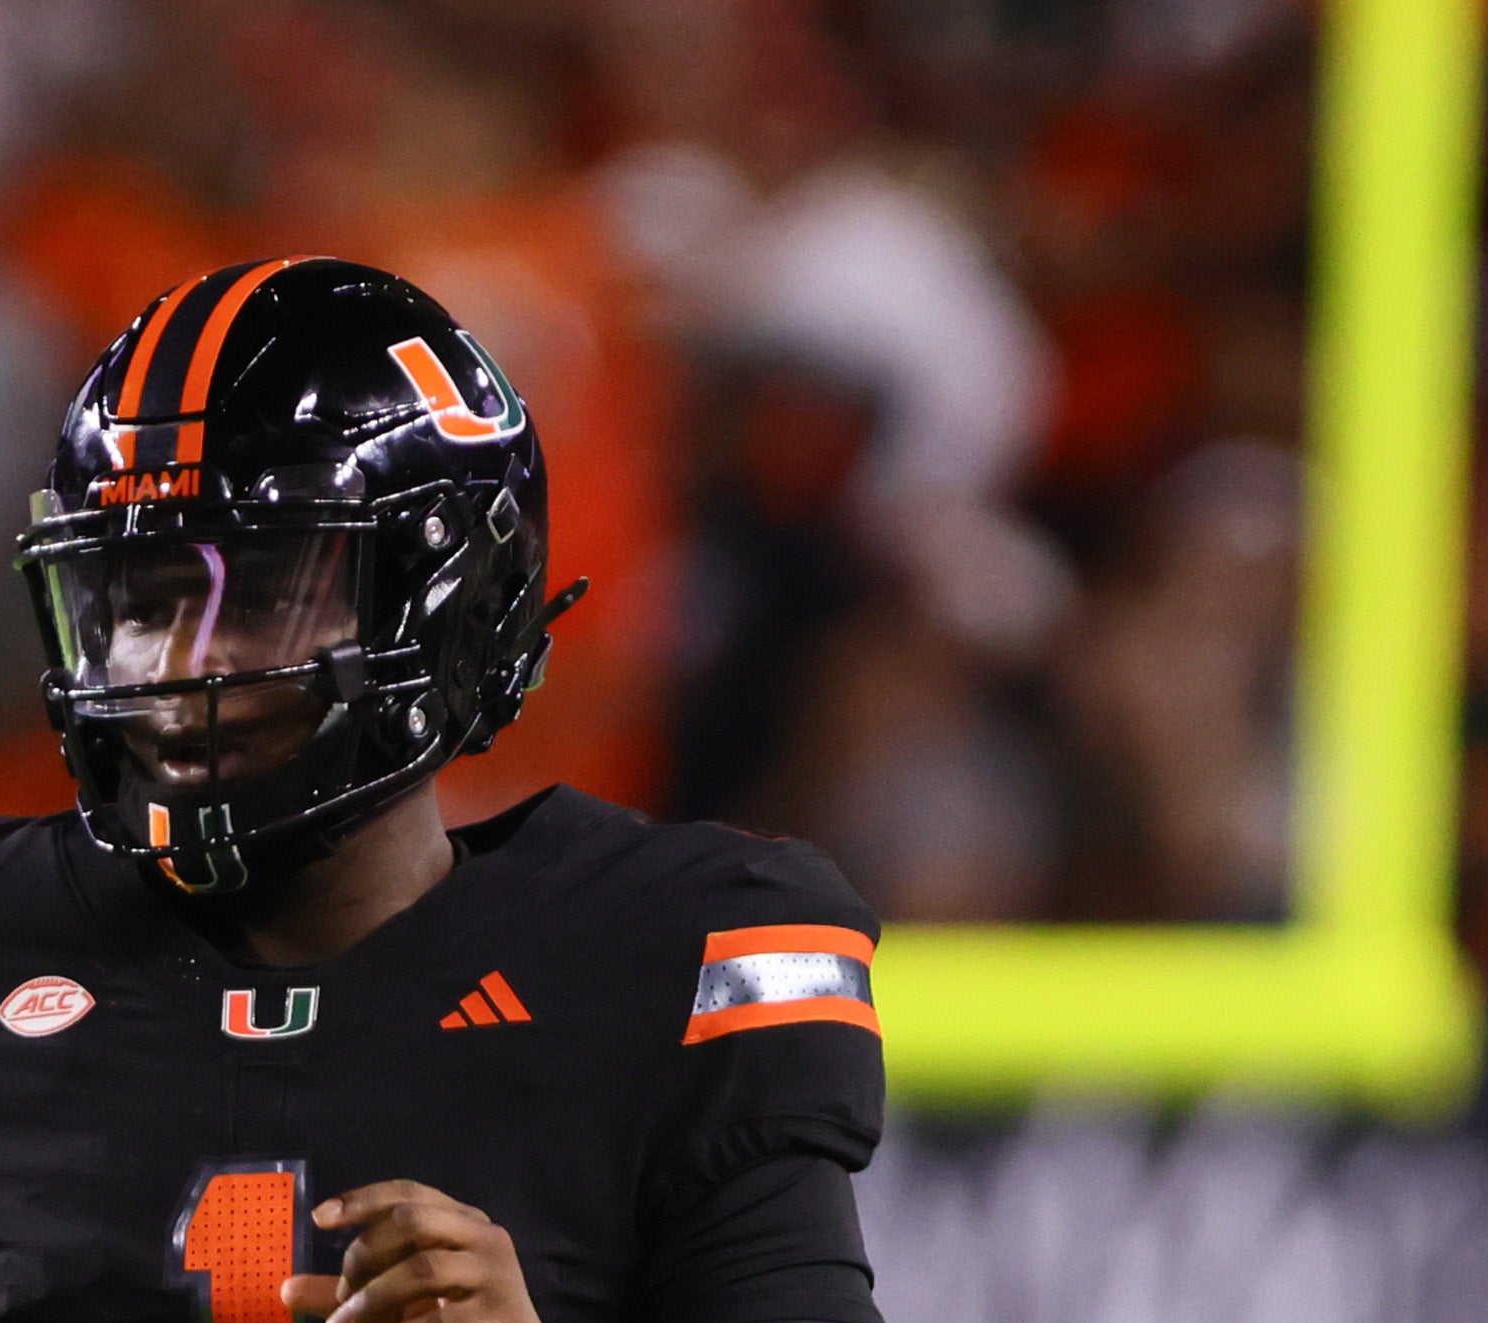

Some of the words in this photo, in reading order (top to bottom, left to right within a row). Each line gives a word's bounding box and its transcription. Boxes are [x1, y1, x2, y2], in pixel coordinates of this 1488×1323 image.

[387, 330, 525, 442] U
[101, 468, 200, 507] MIAMI
[11, 989, 78, 1015] ACC
[221, 986, 320, 1039] U
